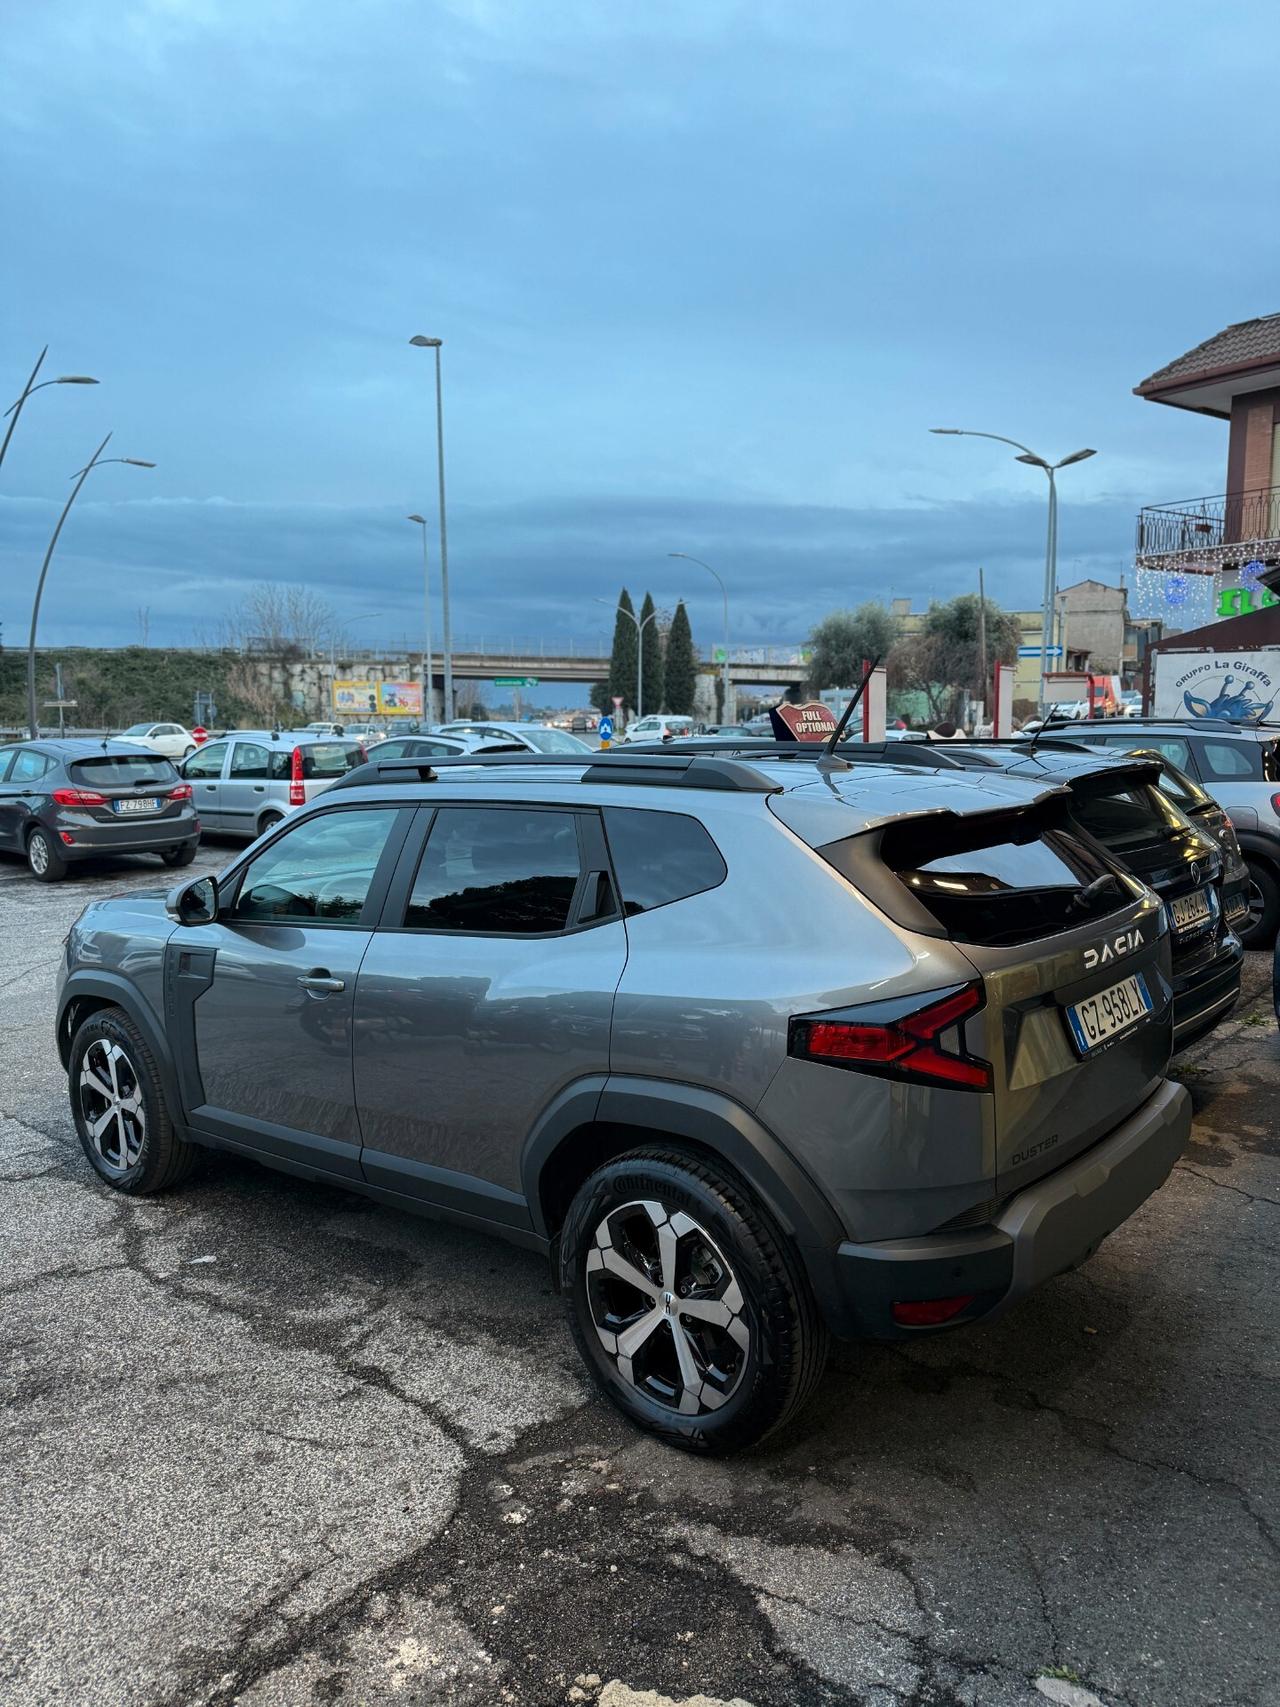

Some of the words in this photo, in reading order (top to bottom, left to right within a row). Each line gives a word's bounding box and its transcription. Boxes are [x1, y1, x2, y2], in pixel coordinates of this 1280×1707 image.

[1175, 664, 1211, 688] GRUPPO
[1214, 660, 1230, 669] La
[1233, 661, 1272, 687] Giraffa
[795, 721, 837, 733] OPTIONAL
[801, 710, 822, 721] FULL
[119, 800, 131, 810] FZ
[1083, 929, 1145, 970] DACIA
[1081, 1000, 1106, 1040] GZ
[1102, 978, 1146, 1029] 958LX
[1012, 1134, 1059, 1166] DUSTER
[613, 1174, 690, 1208] Continental
